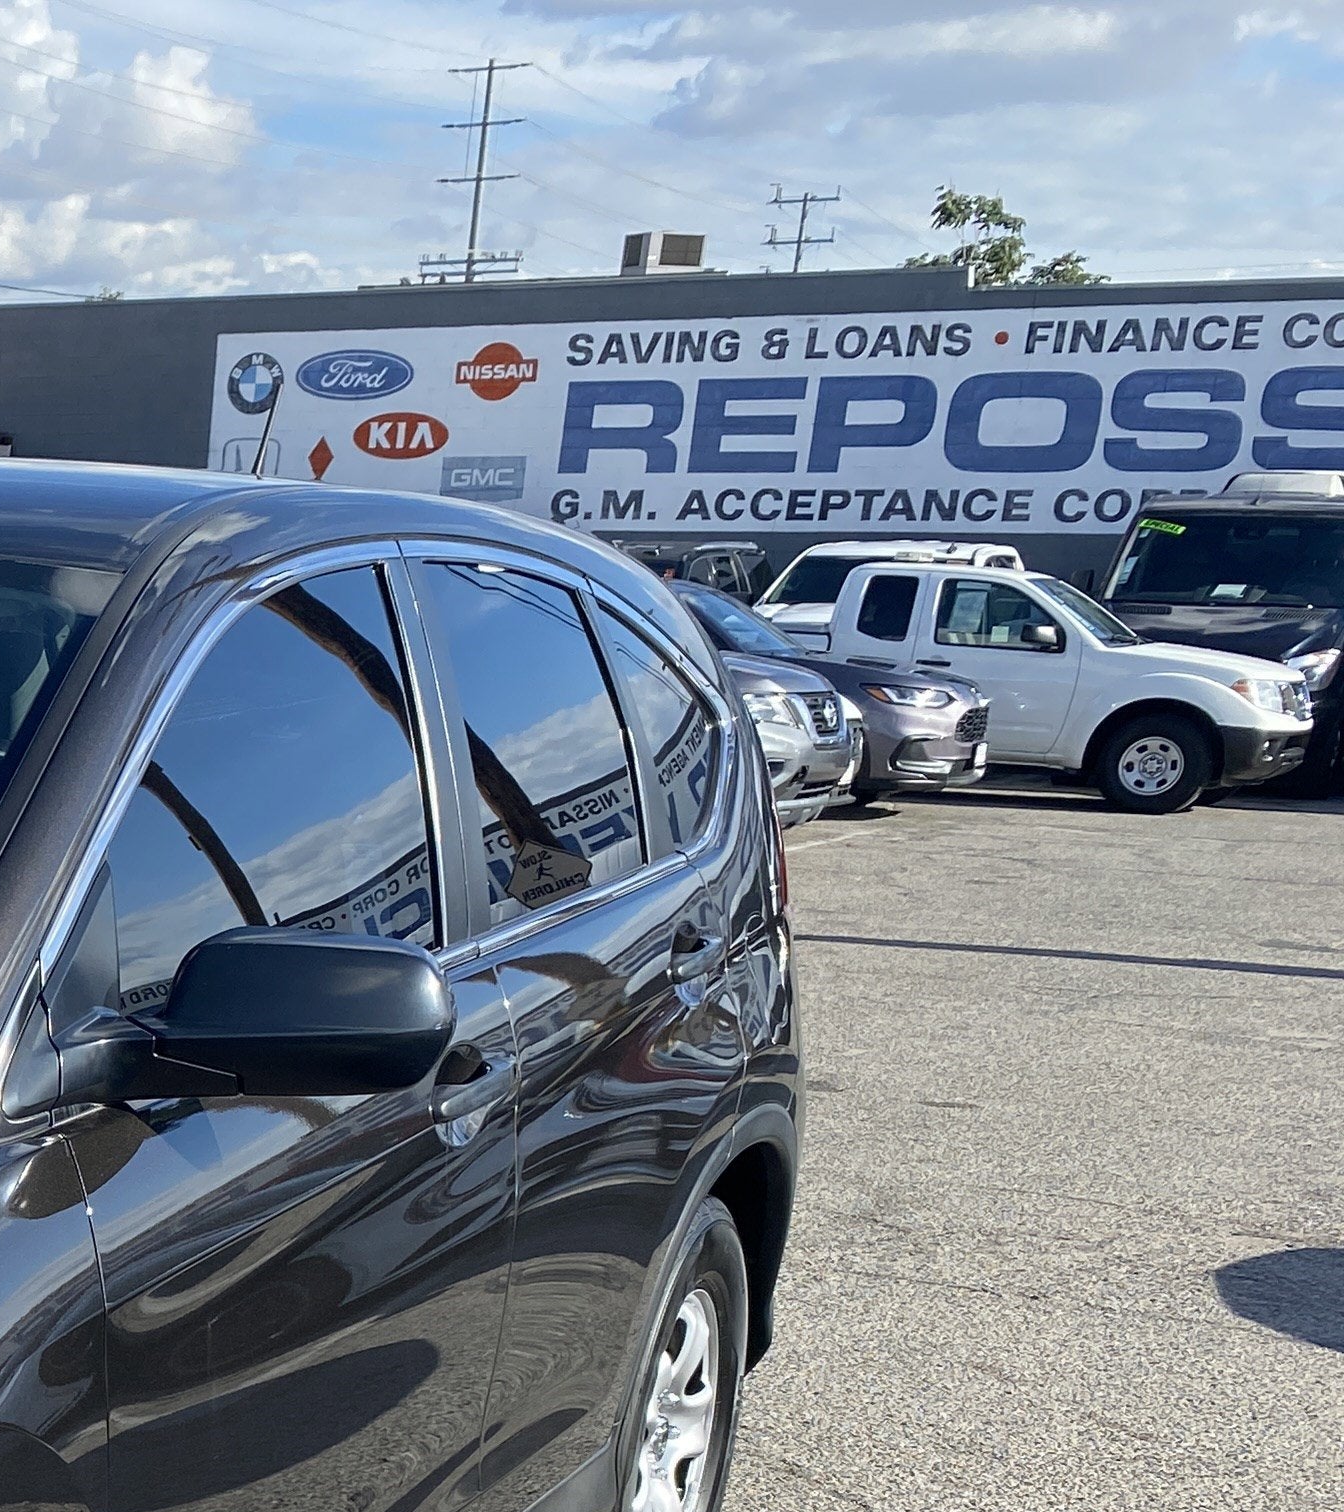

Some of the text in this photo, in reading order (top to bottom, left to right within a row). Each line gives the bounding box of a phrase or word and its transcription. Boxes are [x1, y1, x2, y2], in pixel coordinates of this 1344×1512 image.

[566, 329, 741, 367] SAVING
[761, 328, 790, 361] &
[804, 323, 972, 360] LOANS
[1024, 315, 1265, 354] FINANCE
[320, 360, 386, 389] Ford
[459, 364, 534, 380] NISSAN
[557, 365, 1344, 474] REPOSS
[367, 421, 435, 449] KIA
[450, 467, 515, 487] GMC
[550, 488, 657, 523] G.M.
[675, 488, 1034, 522] ACCEPTANCE
